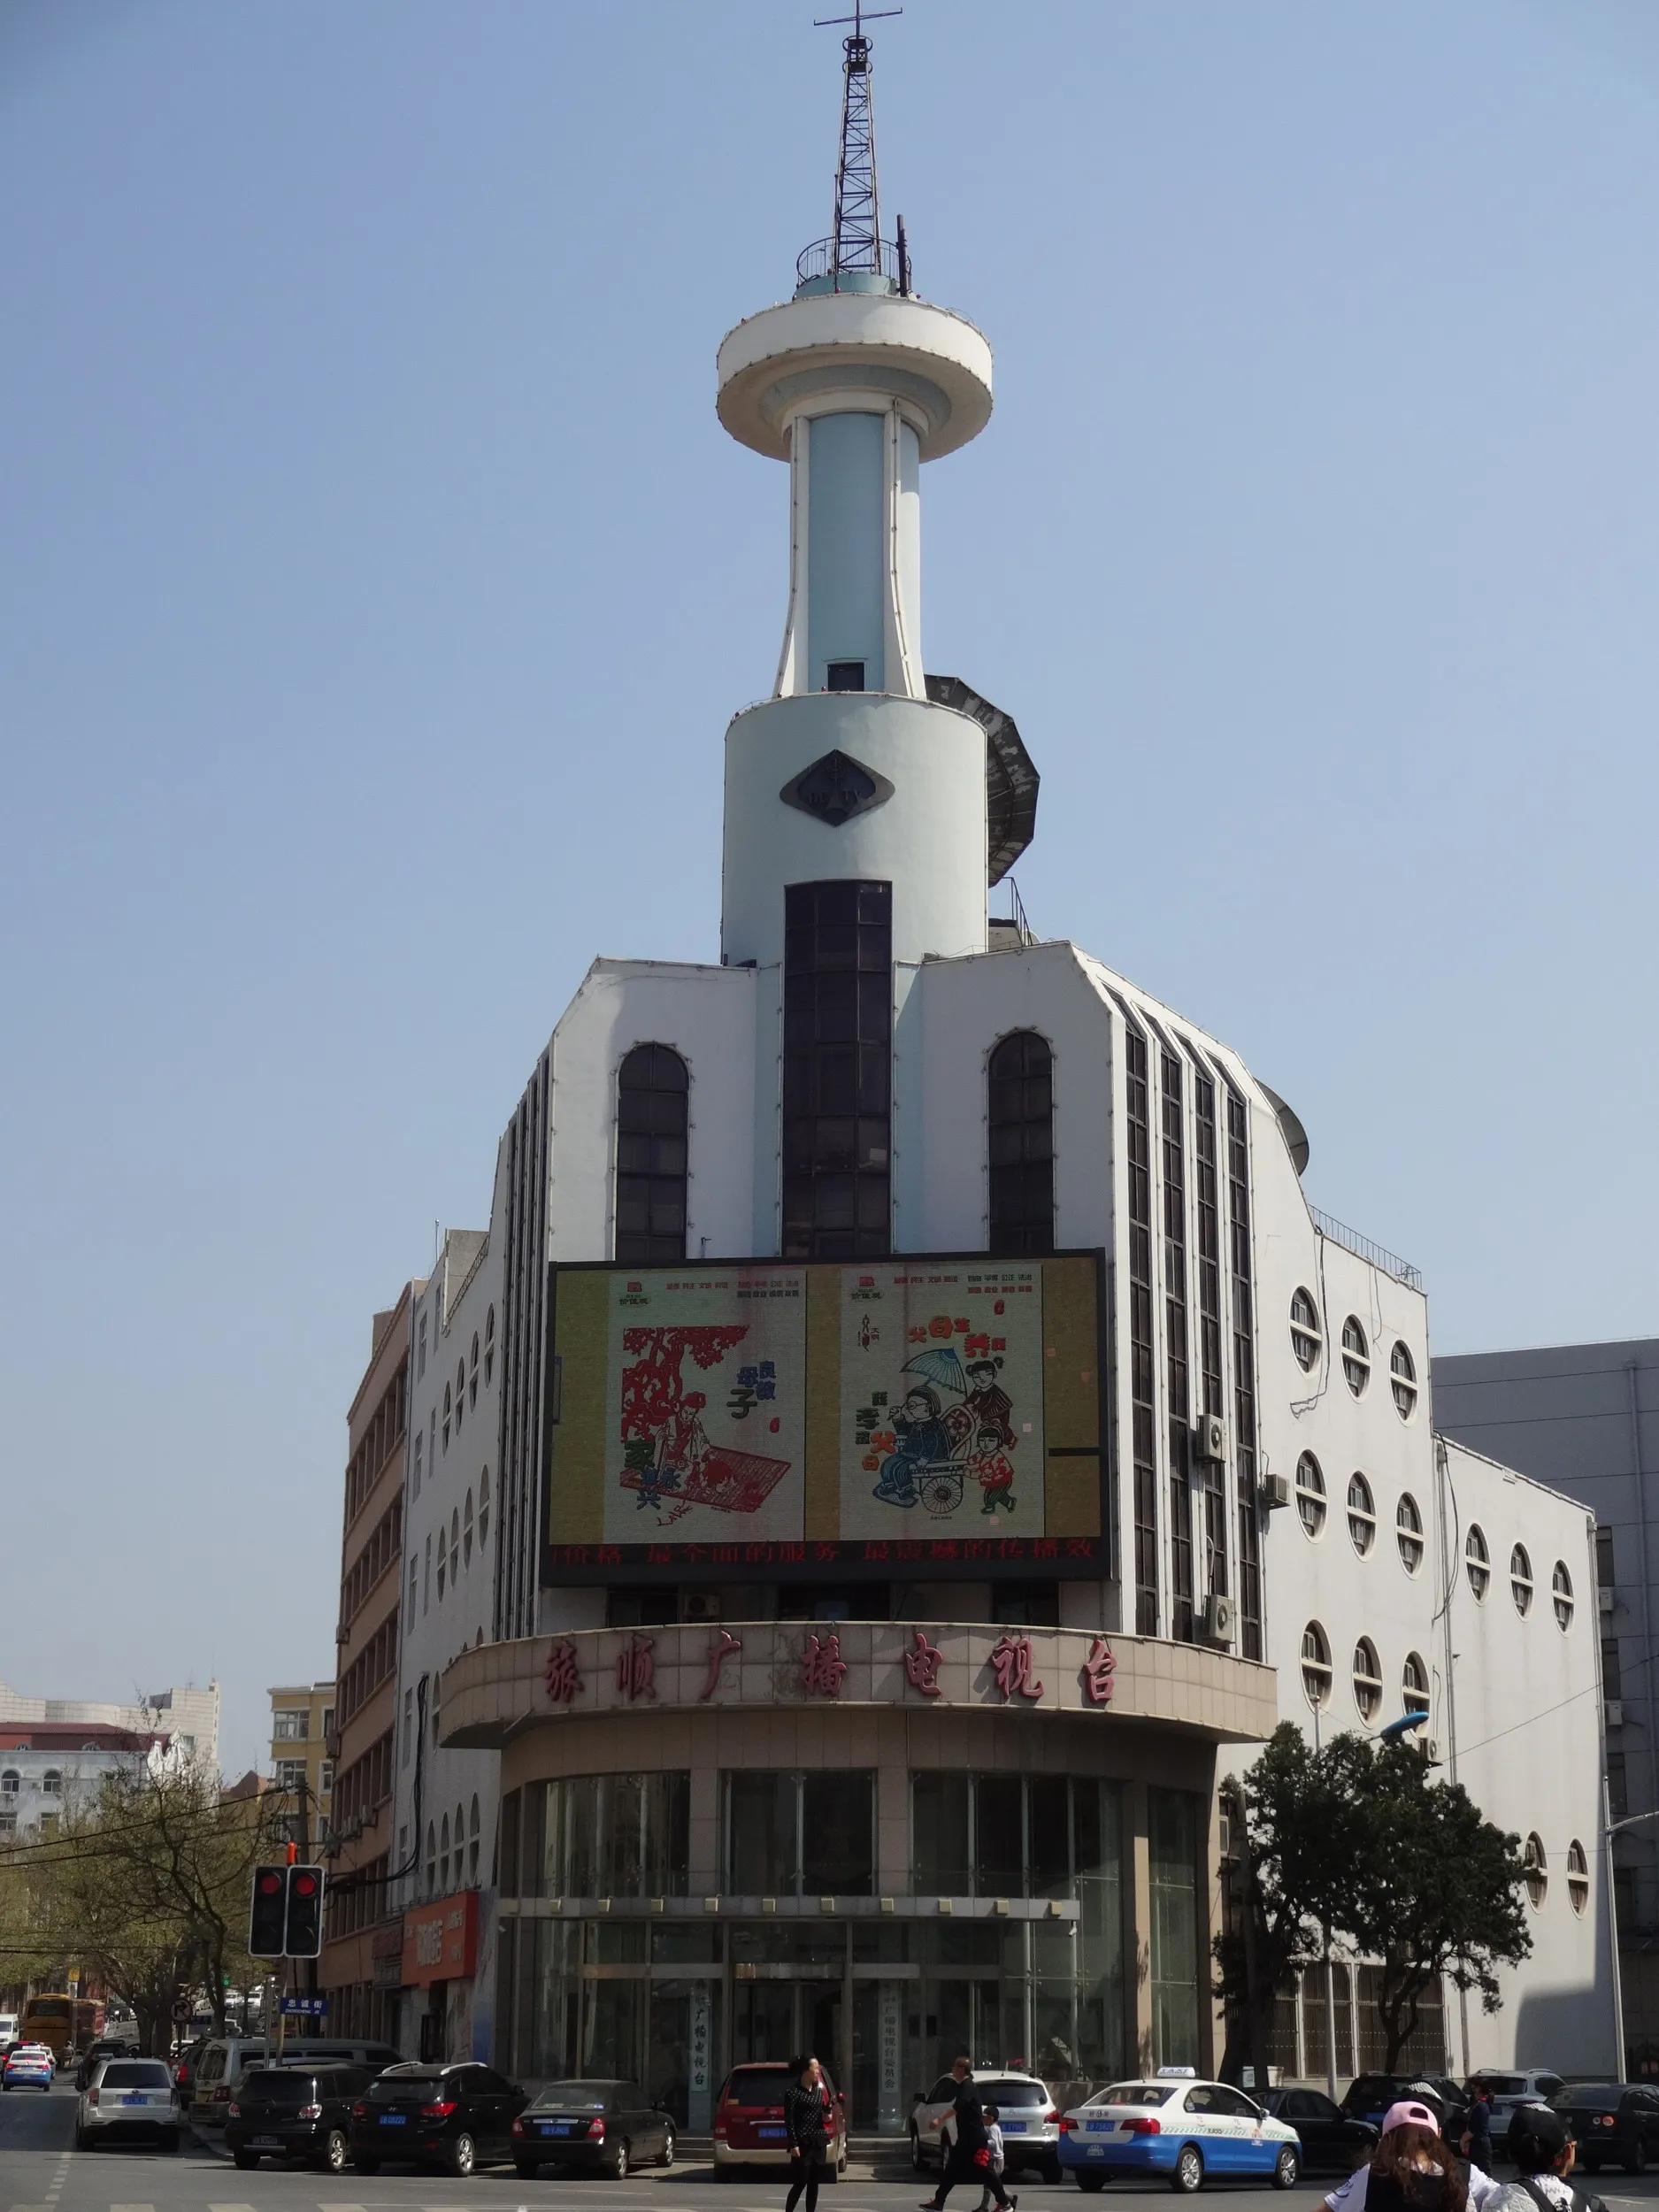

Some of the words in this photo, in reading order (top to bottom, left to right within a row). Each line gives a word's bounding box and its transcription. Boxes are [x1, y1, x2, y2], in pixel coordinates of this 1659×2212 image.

[546, 1630, 1117, 1702] 旅顺广播电视台
[287, 1999, 323, 2008] 忠诚街
